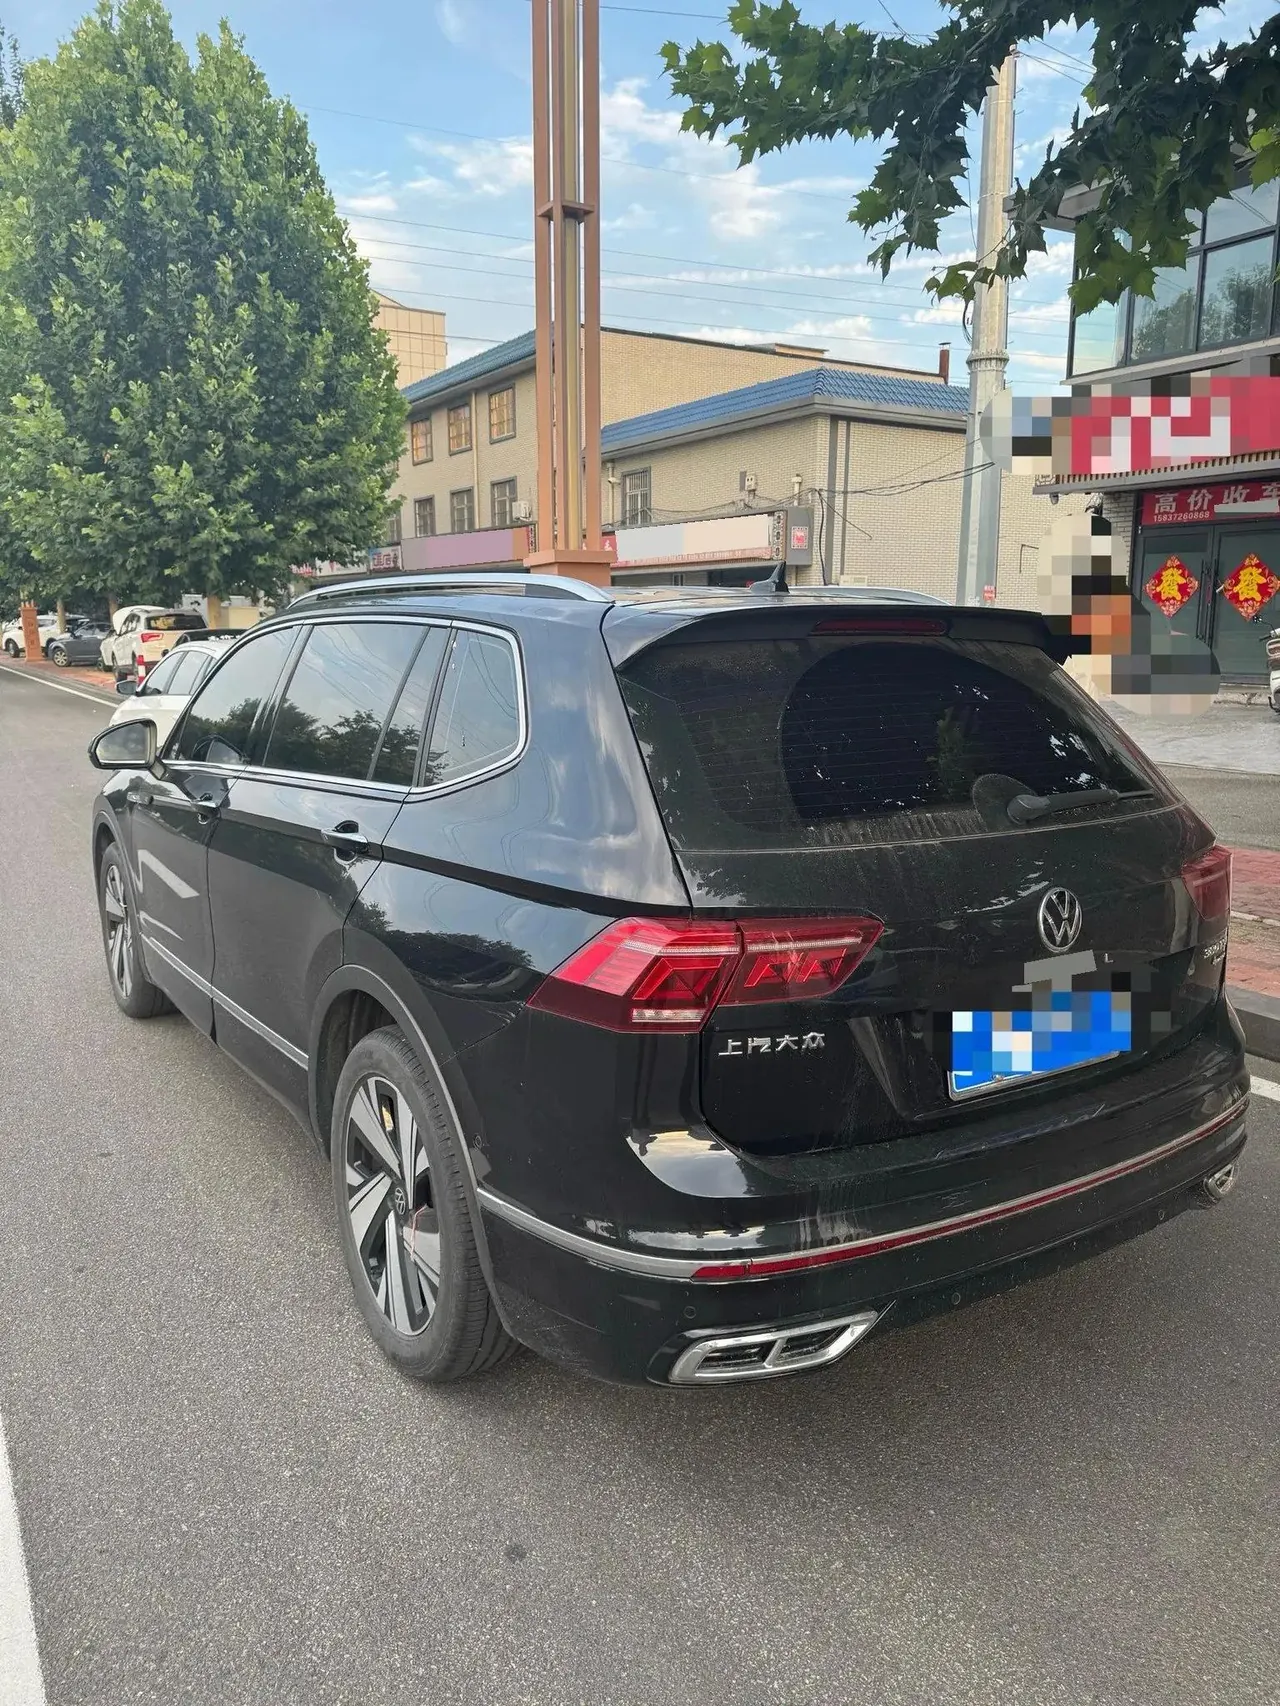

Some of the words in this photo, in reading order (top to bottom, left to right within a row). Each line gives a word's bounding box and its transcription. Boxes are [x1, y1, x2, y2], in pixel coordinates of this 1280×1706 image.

[1153, 511, 1210, 523] 15837260868
[1104, 952, 1114, 963] L
[718, 1031, 826, 1056] 上汽大众
